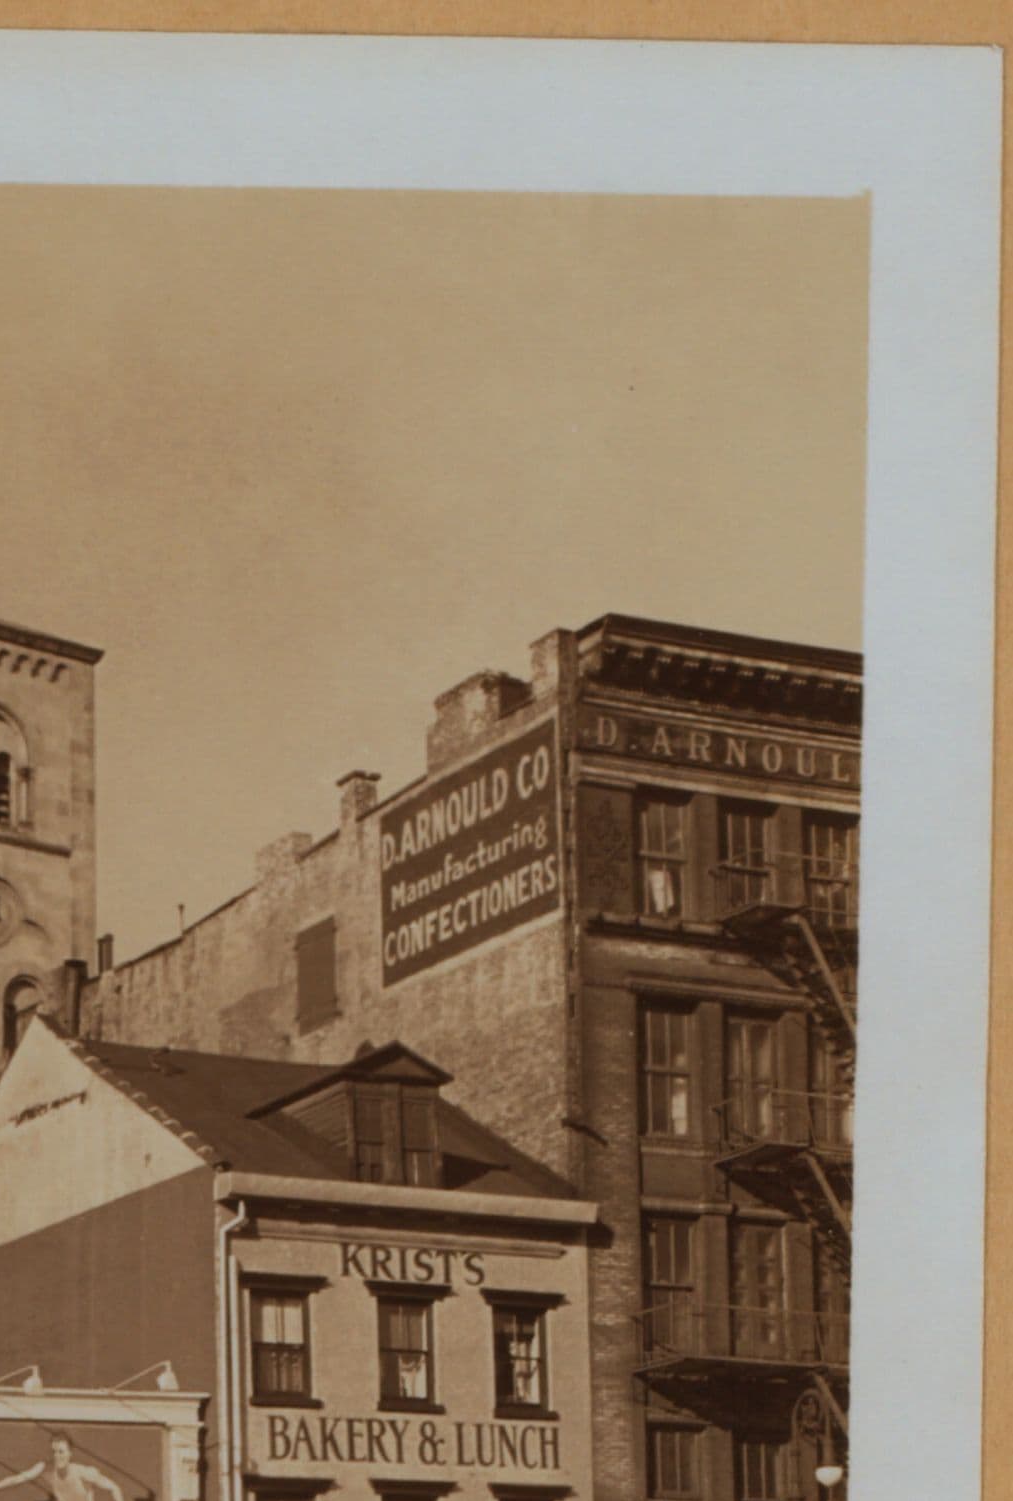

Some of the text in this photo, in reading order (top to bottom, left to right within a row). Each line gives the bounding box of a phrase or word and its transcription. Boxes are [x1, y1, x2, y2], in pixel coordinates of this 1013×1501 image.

[516, 745, 550, 800] CO
[390, 815, 548, 912] Manufacturing
[383, 854, 557, 967] CONFECTIONERS
[266, 1414, 562, 1471] BAKERY & LUNCH
